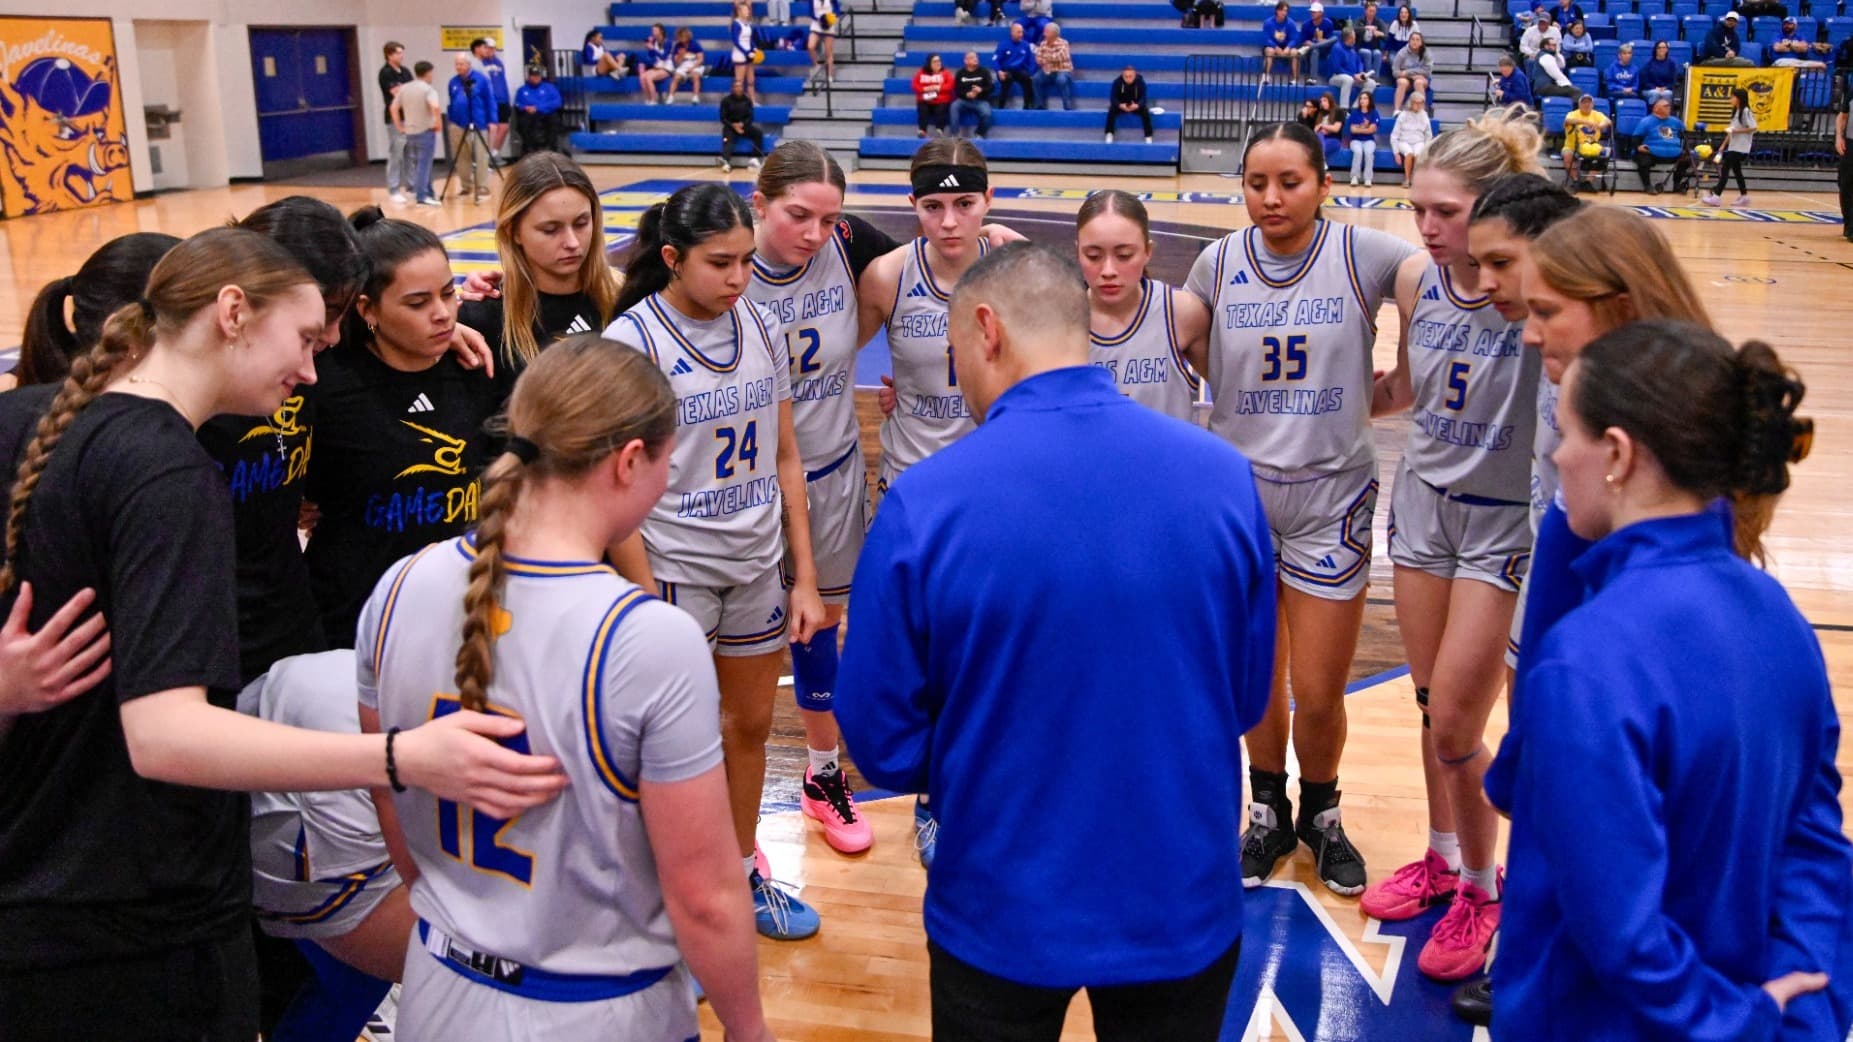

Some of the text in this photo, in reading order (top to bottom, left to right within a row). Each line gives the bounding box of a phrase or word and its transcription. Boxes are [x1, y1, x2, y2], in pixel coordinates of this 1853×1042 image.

[802, 285, 844, 320] A&M
[1226, 297, 1343, 329] TEXAS A&M
[901, 312, 949, 338] TEXA
[1416, 320, 1471, 352] TEXAS
[1123, 358, 1167, 384] A&M
[1261, 334, 1308, 382] 35
[1236, 387, 1343, 415] AVELINAS
[1444, 361, 1472, 413] 5
[913, 394, 970, 419] JAVEL
[1423, 409, 1514, 451] VELINAS
[714, 418, 759, 480] 24
[364, 478, 481, 533] GAMEDA
[677, 475, 777, 518] JAVELINA
